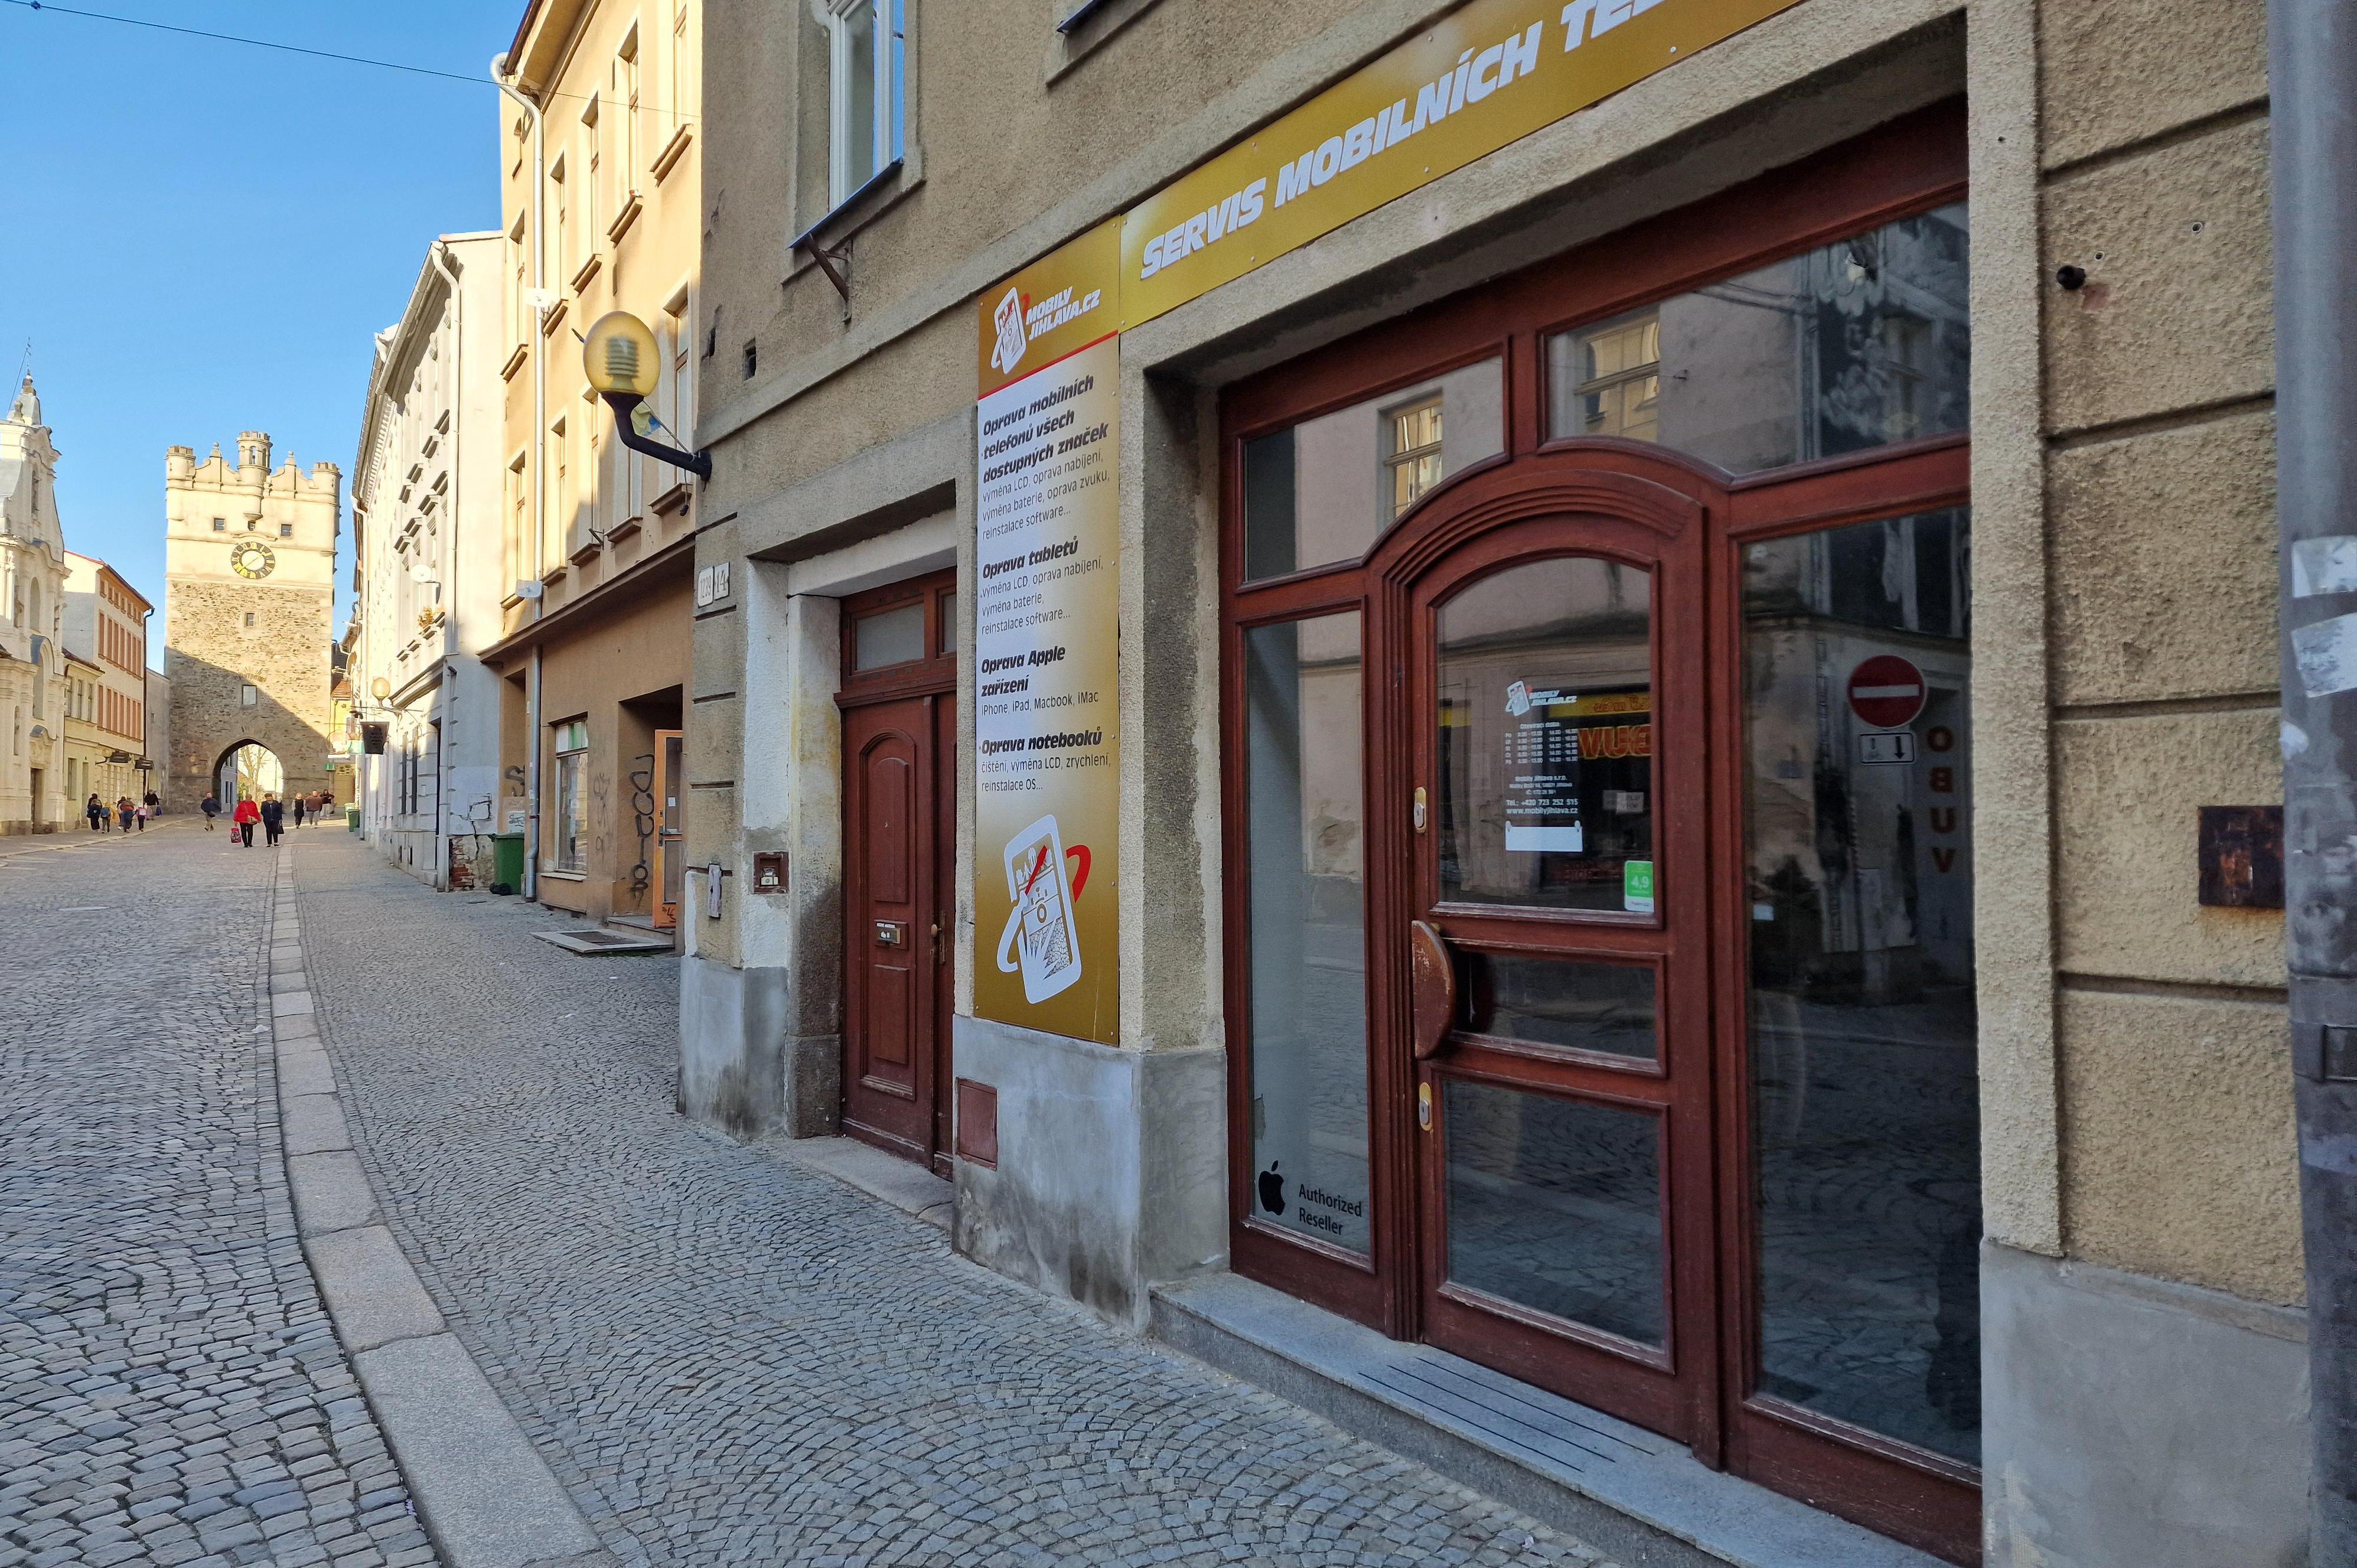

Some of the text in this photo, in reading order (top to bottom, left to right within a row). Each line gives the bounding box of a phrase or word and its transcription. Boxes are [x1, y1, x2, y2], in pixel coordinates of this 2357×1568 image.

[1140, 0, 1665, 281] SERVIS MOBILNÍCH TE
[1026, 286, 1072, 325] MOBILY
[1029, 289, 1101, 340] JIHLAVA.CZ
[983, 374, 1094, 437] Oprava mobilních
[983, 409, 1075, 459] telefonů všech
[983, 422, 1109, 483] dostupných značek
[983, 448, 1103, 503] výměna LCD, oprava nabíjení,
[983, 470, 1110, 522] výměna baterie, oprava zvuku,
[983, 505, 1071, 540] reinstalace software...
[983, 535, 1078, 579] Oprava tabletů
[716, 569, 728, 593] 14
[983, 555, 1103, 598] výměna LCD, oprava nabíjení,
[982, 592, 1044, 617] výměna baterie,
[982, 608, 1070, 635] reinstalace software...
[981, 646, 1065, 674] Oprava Apple
[981, 674, 1029, 697] zařízení
[1012, 699, 1032, 712] iPad,
[1034, 693, 1075, 709] Macbook,
[1078, 692, 1098, 704] iMac
[982, 726, 1102, 756] Oprava notebooků
[982, 752, 1111, 774] čištění, výměna LCD, zrychlení,
[982, 779, 1023, 792] reinstalace
[1299, 1184, 1362, 1217] Authorized
[1299, 1207, 1343, 1236] Reseller
